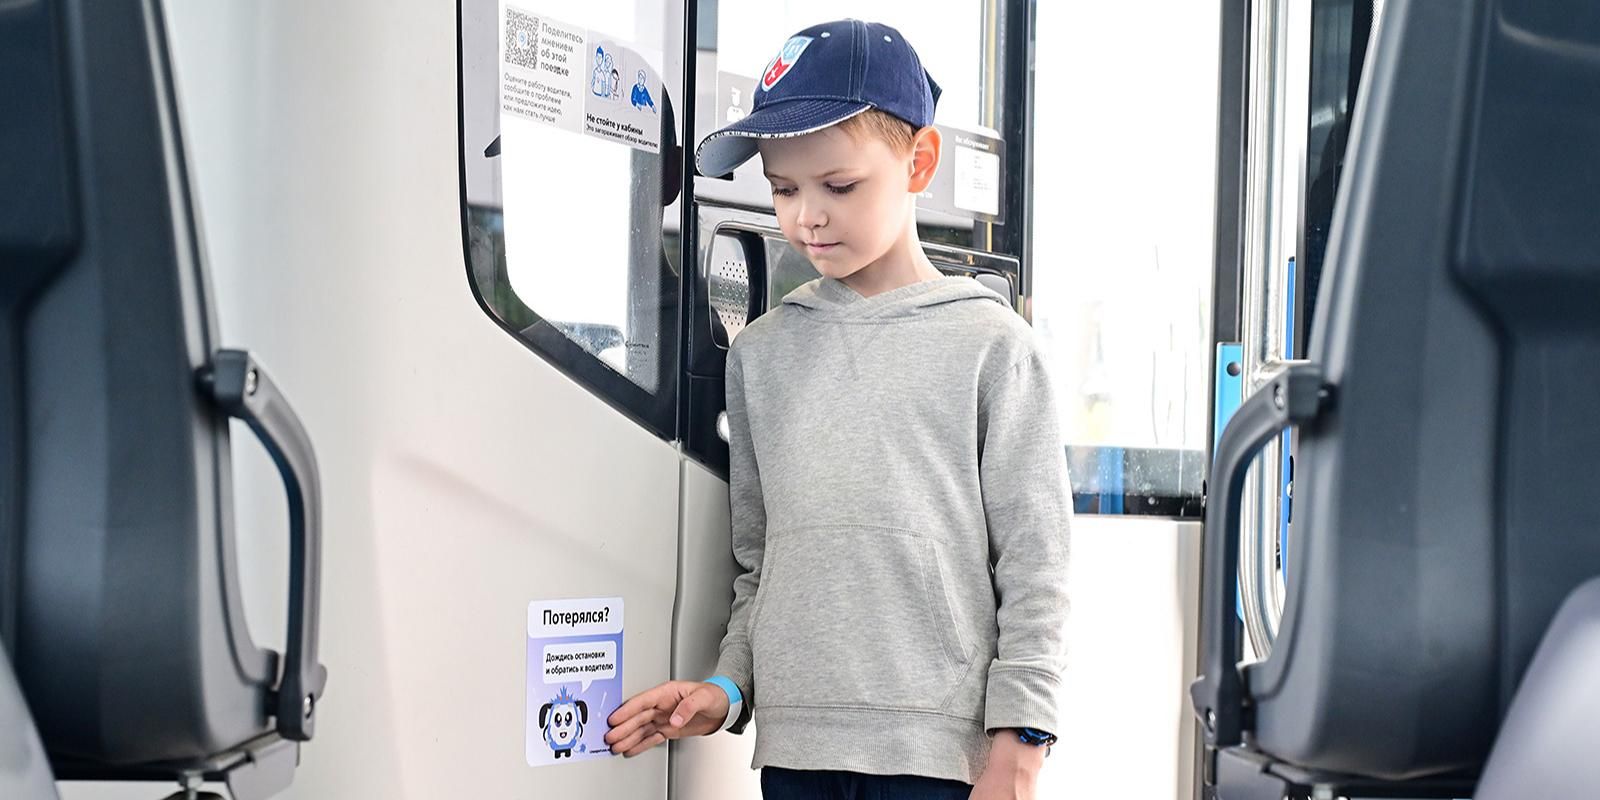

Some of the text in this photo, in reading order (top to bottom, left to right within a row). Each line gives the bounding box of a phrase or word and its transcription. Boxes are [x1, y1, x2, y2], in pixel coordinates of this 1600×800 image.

[542, 22, 583, 44] Поделитесь
[541, 38, 574, 53] мнением
[541, 48, 567, 63] об этой
[541, 62, 569, 76] поездке
[504, 72, 527, 86] Оцените
[528, 81, 546, 92] работу
[504, 84, 530, 97] сообщите
[535, 92, 562, 105] проблеме
[515, 97, 546, 111] предложите
[525, 110, 538, 119] стать
[586, 113, 643, 135] Не стойте у кабины
[586, 124, 658, 148] Это загораживает обзор водителю
[543, 607, 610, 627] Потерялся?
[546, 651, 605, 663] Дождись остановки
[551, 665, 579, 675] обратись
[585, 663, 614, 672] водителю
